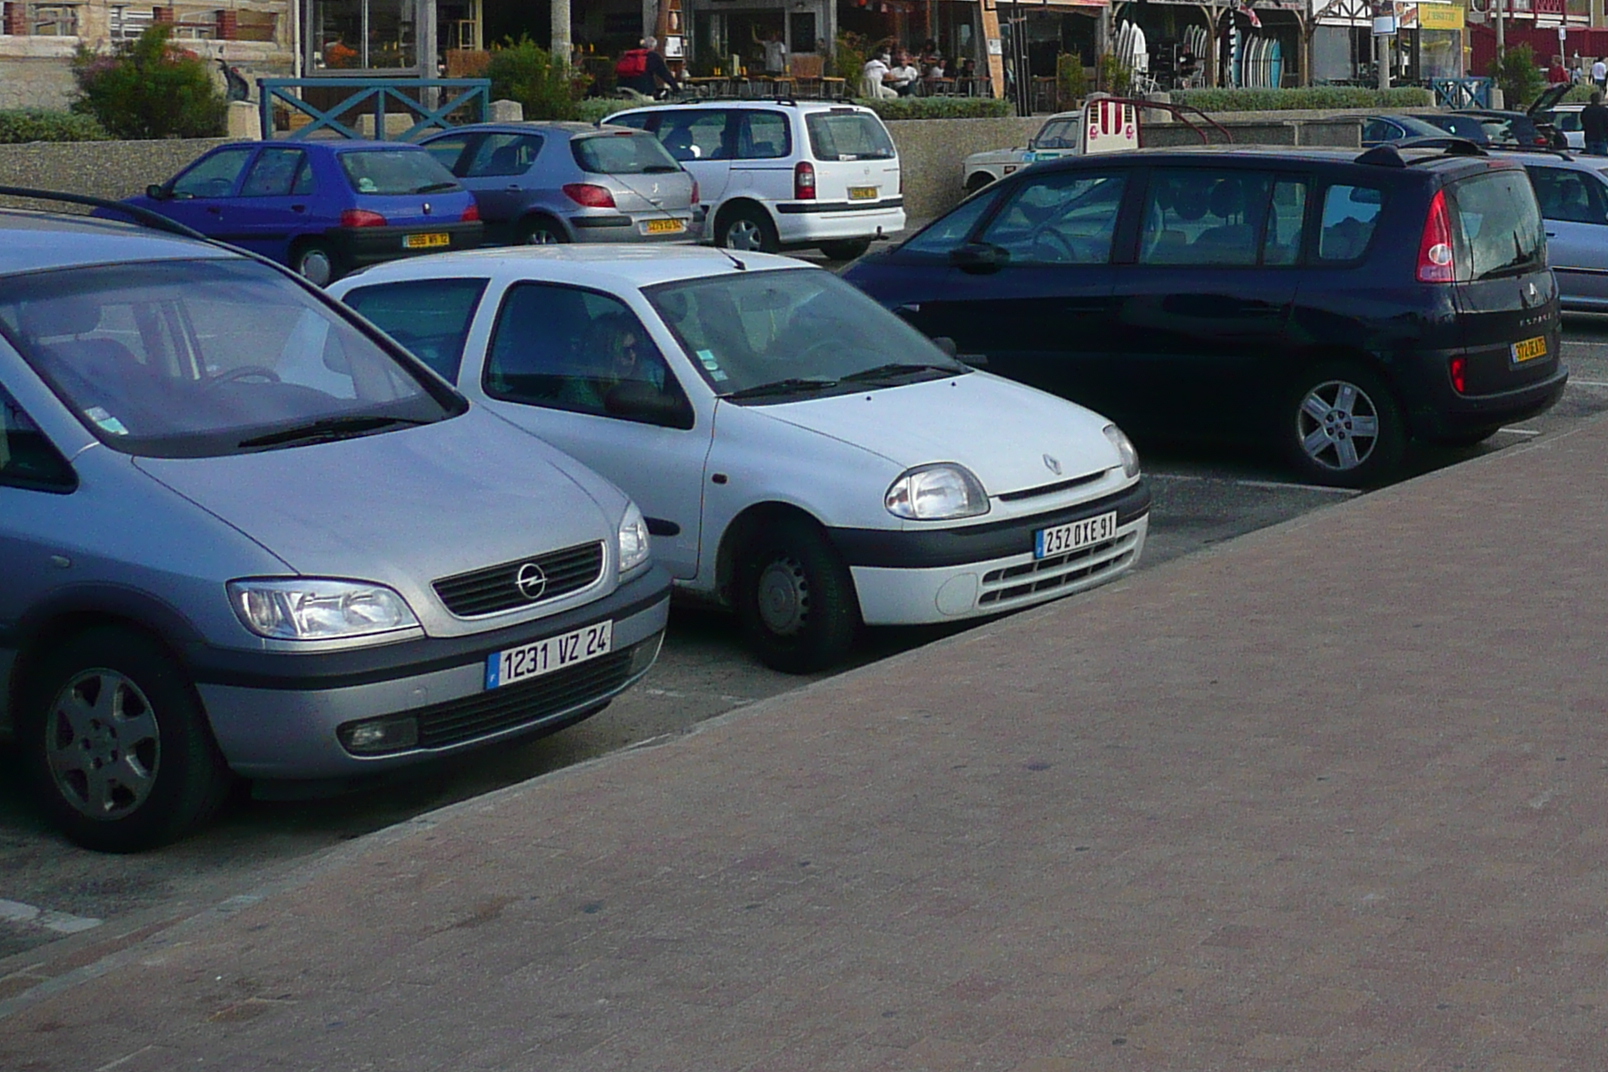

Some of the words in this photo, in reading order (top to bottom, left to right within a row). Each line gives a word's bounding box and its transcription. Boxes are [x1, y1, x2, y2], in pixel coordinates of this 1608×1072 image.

[1046, 527, 1071, 553] 252
[1100, 514, 1113, 538] 91
[504, 642, 549, 679] 1231
[558, 633, 580, 664] VZ
[586, 625, 606, 656] 24
